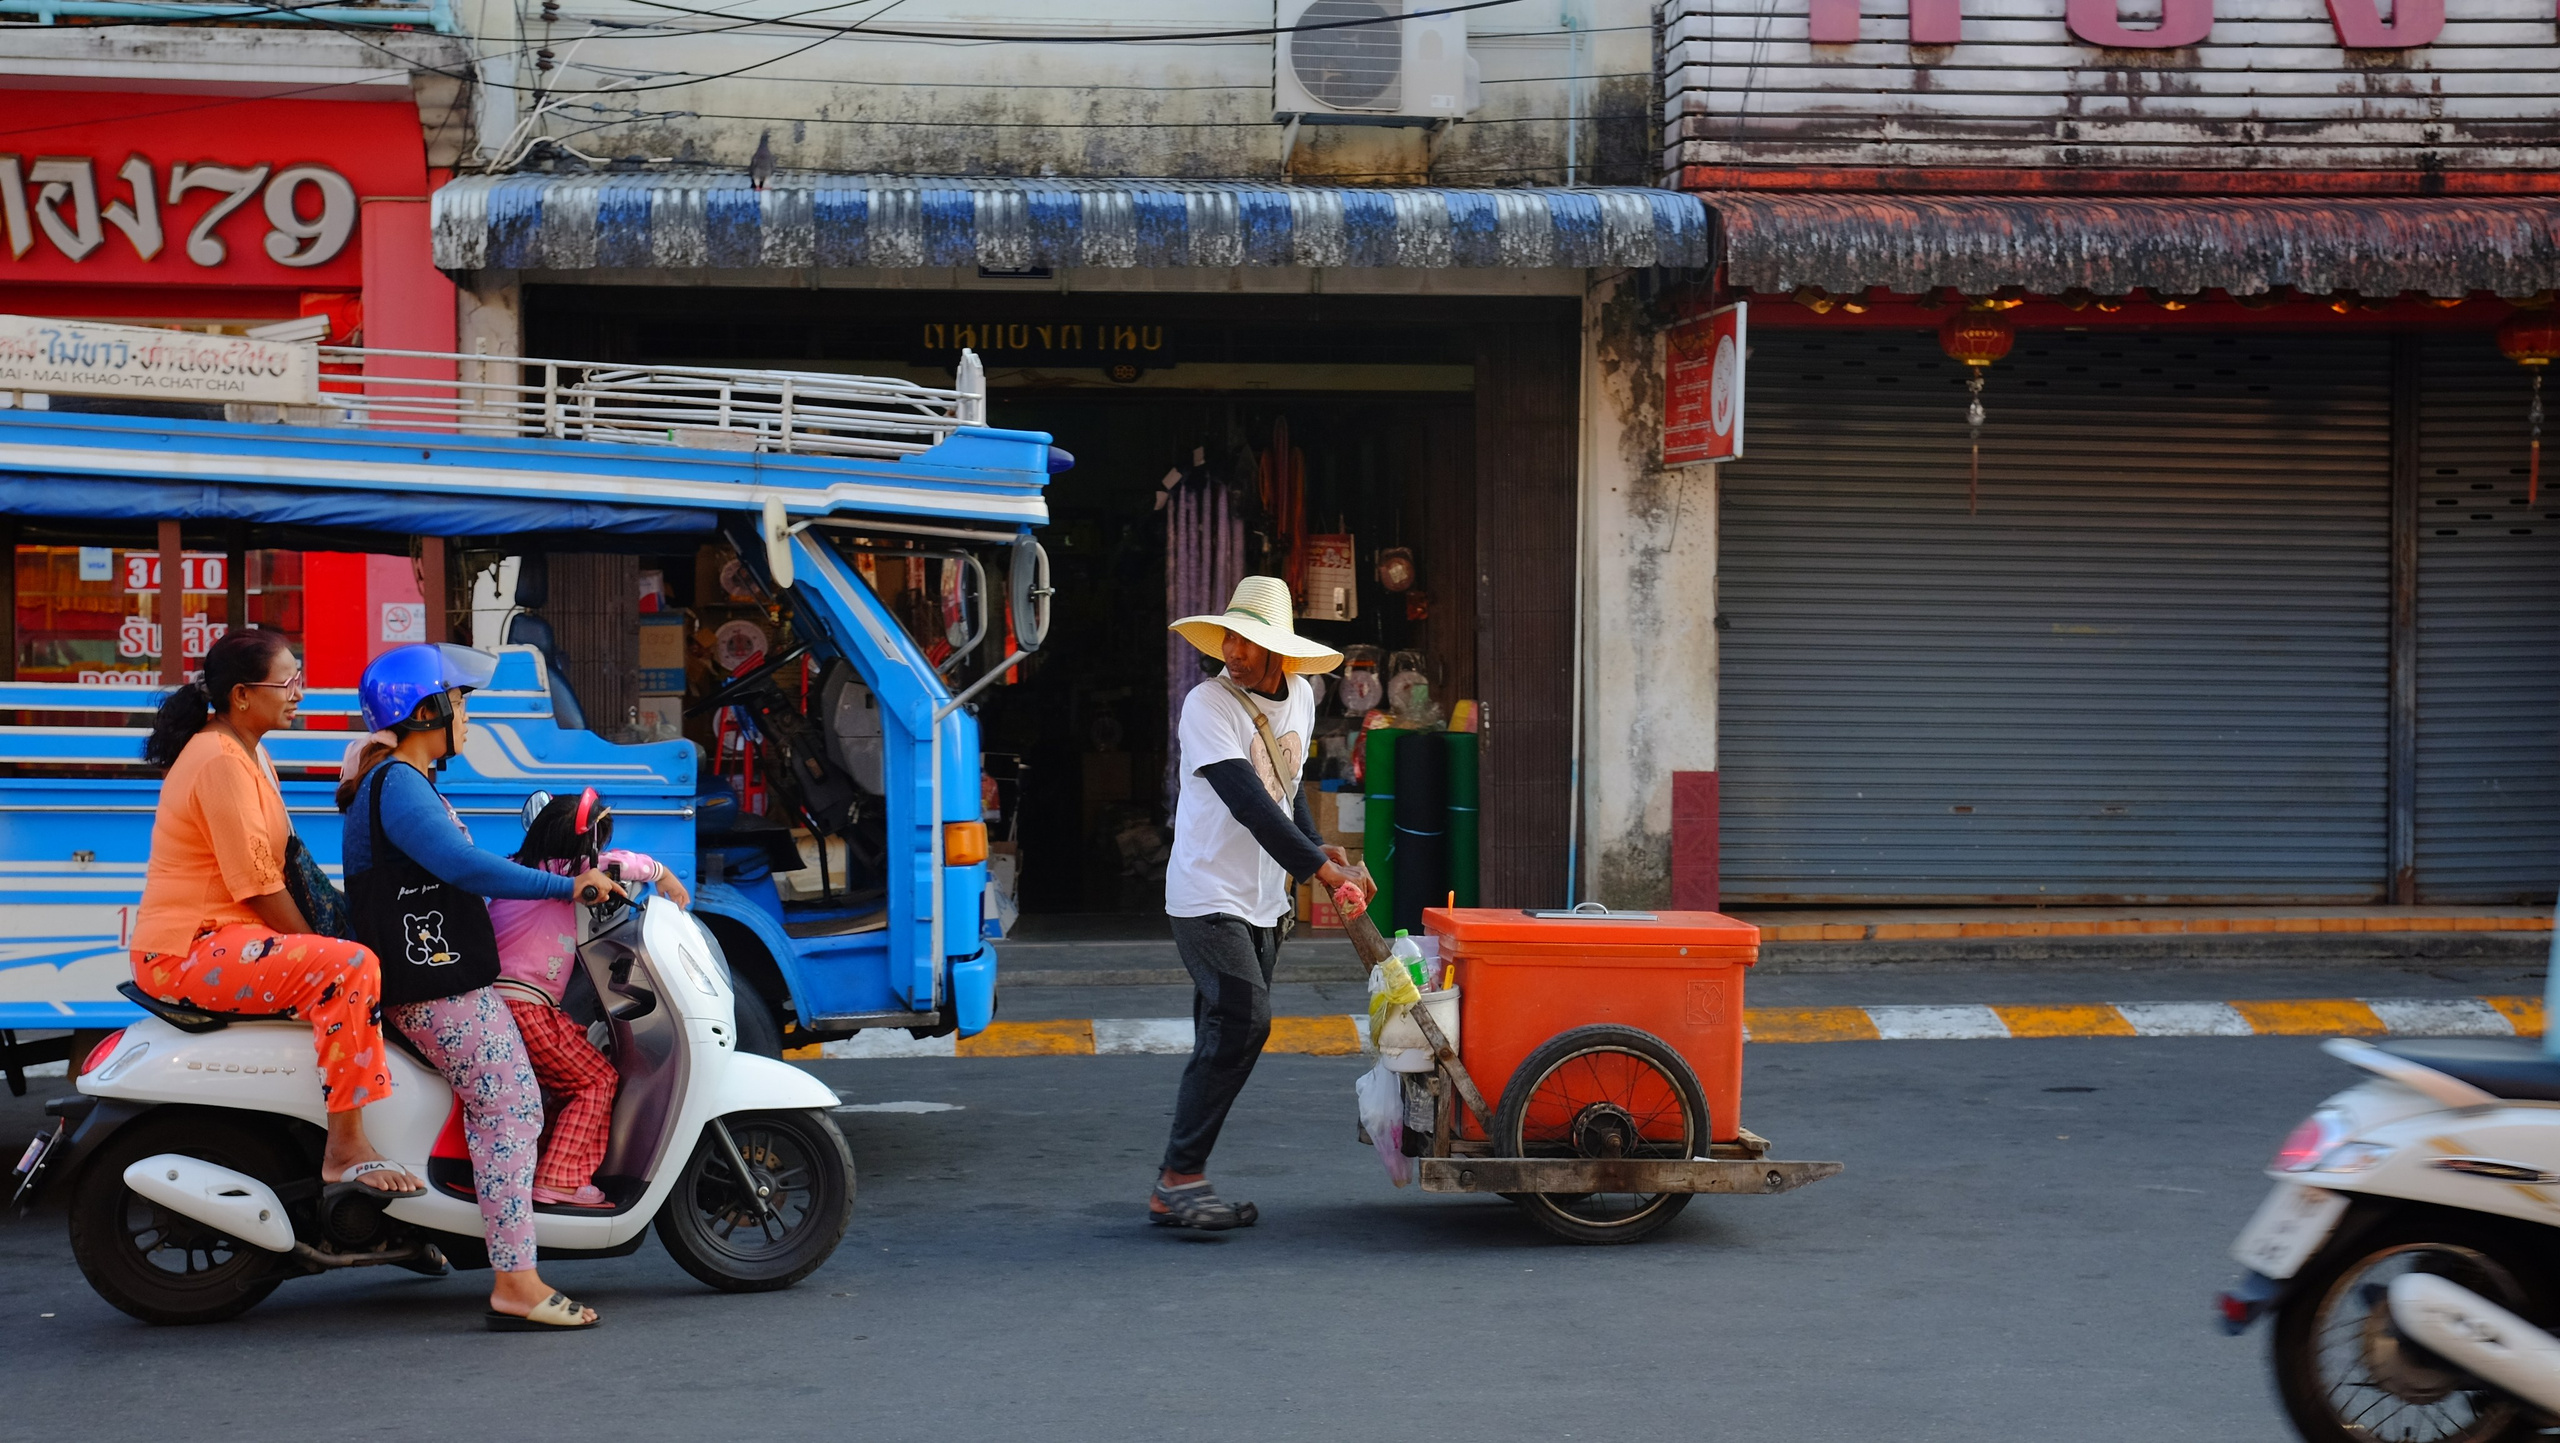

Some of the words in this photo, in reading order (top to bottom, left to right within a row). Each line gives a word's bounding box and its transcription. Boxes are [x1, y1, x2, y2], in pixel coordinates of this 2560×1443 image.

[0, 367, 21, 380] AI
[33, 369, 67, 383] MAI
[72, 371, 121, 385] KHAO
[131, 375, 155, 388] TA
[160, 376, 204, 390] CHAT
[206, 378, 246, 392] CHAI
[187, 1061, 297, 1076] SCOOPY
